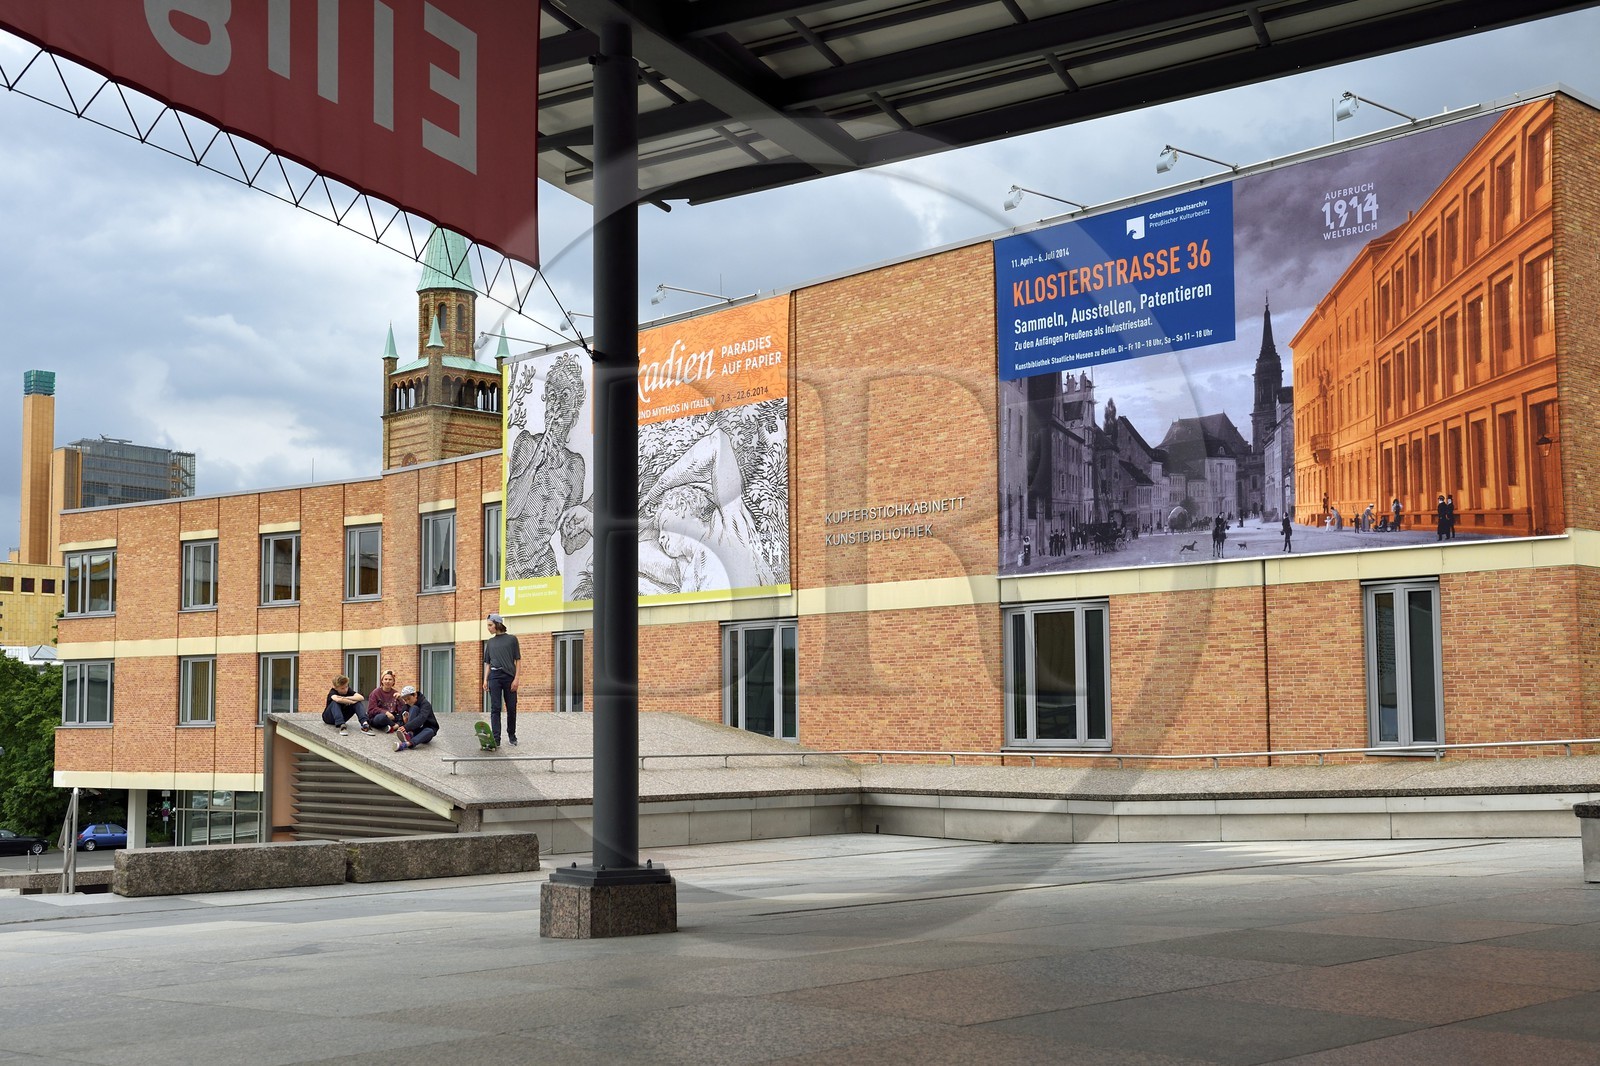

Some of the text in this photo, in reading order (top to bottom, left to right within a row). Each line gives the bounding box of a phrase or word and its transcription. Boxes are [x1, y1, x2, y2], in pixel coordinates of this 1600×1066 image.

[1324, 182, 1374, 200] AUFBRUCH
[1148, 200, 1208, 220] Geheimes Staatsarchiv
[1150, 208, 1210, 228] Preußischer Kulturbesitz
[1321, 192, 1379, 230] 1914
[1323, 222, 1378, 240] WELTBRUCH
[1011, 260, 1020, 268] 11.
[1020, 256, 1034, 268] April
[1038, 254, 1044, 262] 6.
[1044, 250, 1055, 260] Juli
[1056, 248, 1070, 258] 2014
[1013, 239, 1211, 307] KLOSTERSTRASSE 36
[1014, 283, 1212, 334] Sammeln, Ausstellen, Patentieren
[1035, 334, 1063, 347] Anfängen
[1064, 330, 1092, 342] Preußens
[1094, 327, 1104, 335] als
[1106, 316, 1152, 334] Industriestaat.
[722, 336, 772, 358] PARADIES
[1015, 358, 1050, 370] Kunstbibliothek
[1051, 354, 1074, 364] Staatliche
[1076, 352, 1094, 360] Museen
[1101, 346, 1117, 356] Berlin.
[1118, 344, 1124, 352] Di
[1152, 338, 1164, 346] Uhr,
[1196, 330, 1202, 338] 18
[1203, 328, 1212, 336] Uhr
[722, 352, 782, 376] AUF PAPIER
[652, 404, 680, 416] MYTHOS
[682, 402, 688, 412] IN
[690, 396, 716, 410] ITALIEN
[825, 496, 965, 526] KUPFERSTICHKABINETT
[825, 524, 934, 546] KUNSTBIBLIOTHEK
